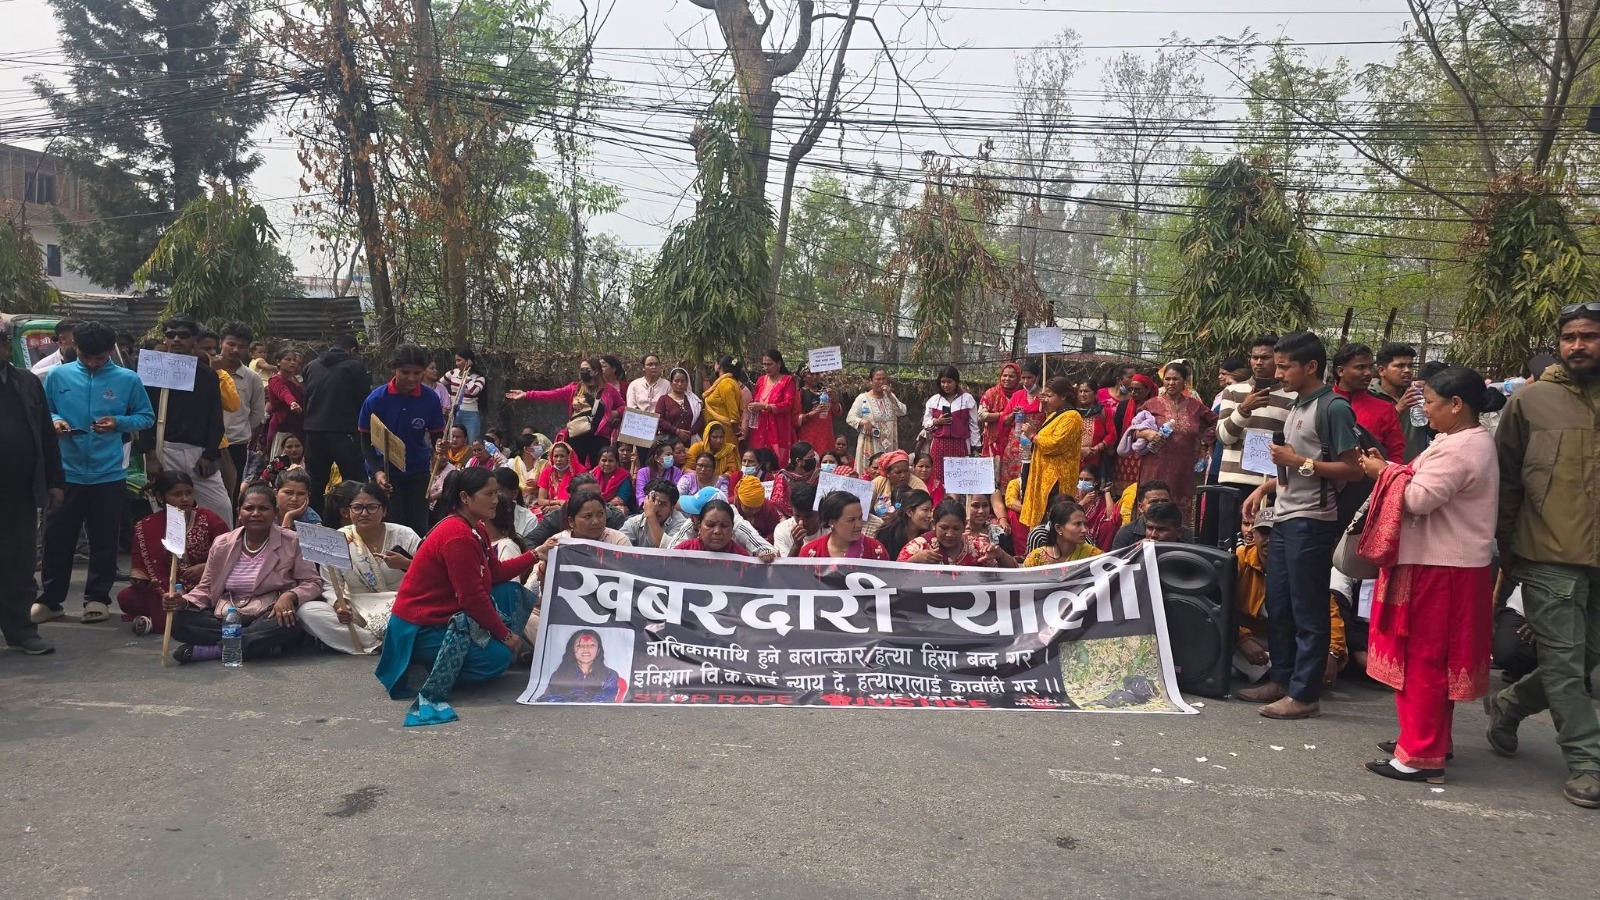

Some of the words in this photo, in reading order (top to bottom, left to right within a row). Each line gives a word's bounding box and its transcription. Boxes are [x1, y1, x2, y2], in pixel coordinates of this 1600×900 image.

[557, 564, 897, 636] खबरदारी
[646, 636, 749, 662] बालिकामाथि
[757, 645, 781, 669] हुने
[920, 642, 959, 671] हिंसा
[966, 651, 999, 670] बन्द
[785, 674, 826, 691] न्याय
[832, 671, 850, 693] दे,
[856, 672, 942, 694] हत्यारालाई
[948, 675, 1006, 695] कार्वाही
[1011, 679, 1040, 695] गर
[717, 693, 794, 704] RAPE
[853, 696, 991, 708] JUSTICE
